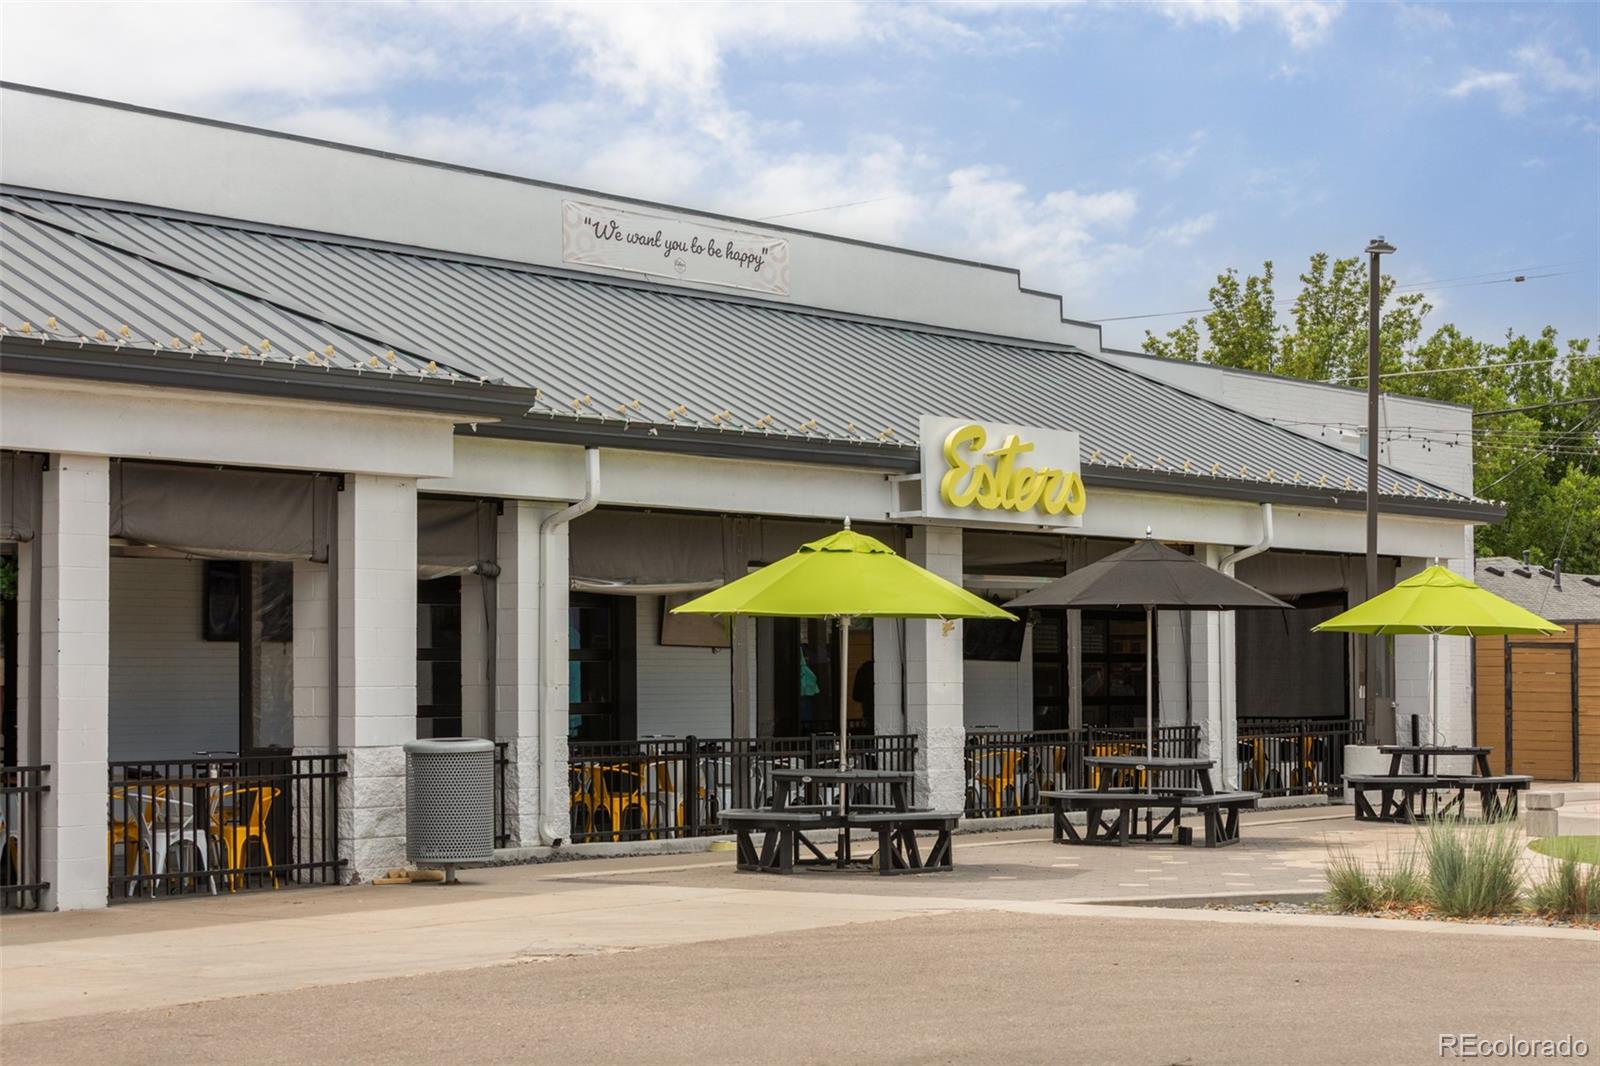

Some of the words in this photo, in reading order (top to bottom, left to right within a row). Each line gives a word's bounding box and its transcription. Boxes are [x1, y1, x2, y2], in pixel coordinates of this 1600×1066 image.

[584, 217, 623, 241] "We
[626, 230, 662, 248] want
[663, 238, 688, 257] you
[690, 237, 705, 254] to
[707, 239, 723, 258] be
[725, 242, 769, 272] happy"
[940, 424, 1086, 516] Esters
